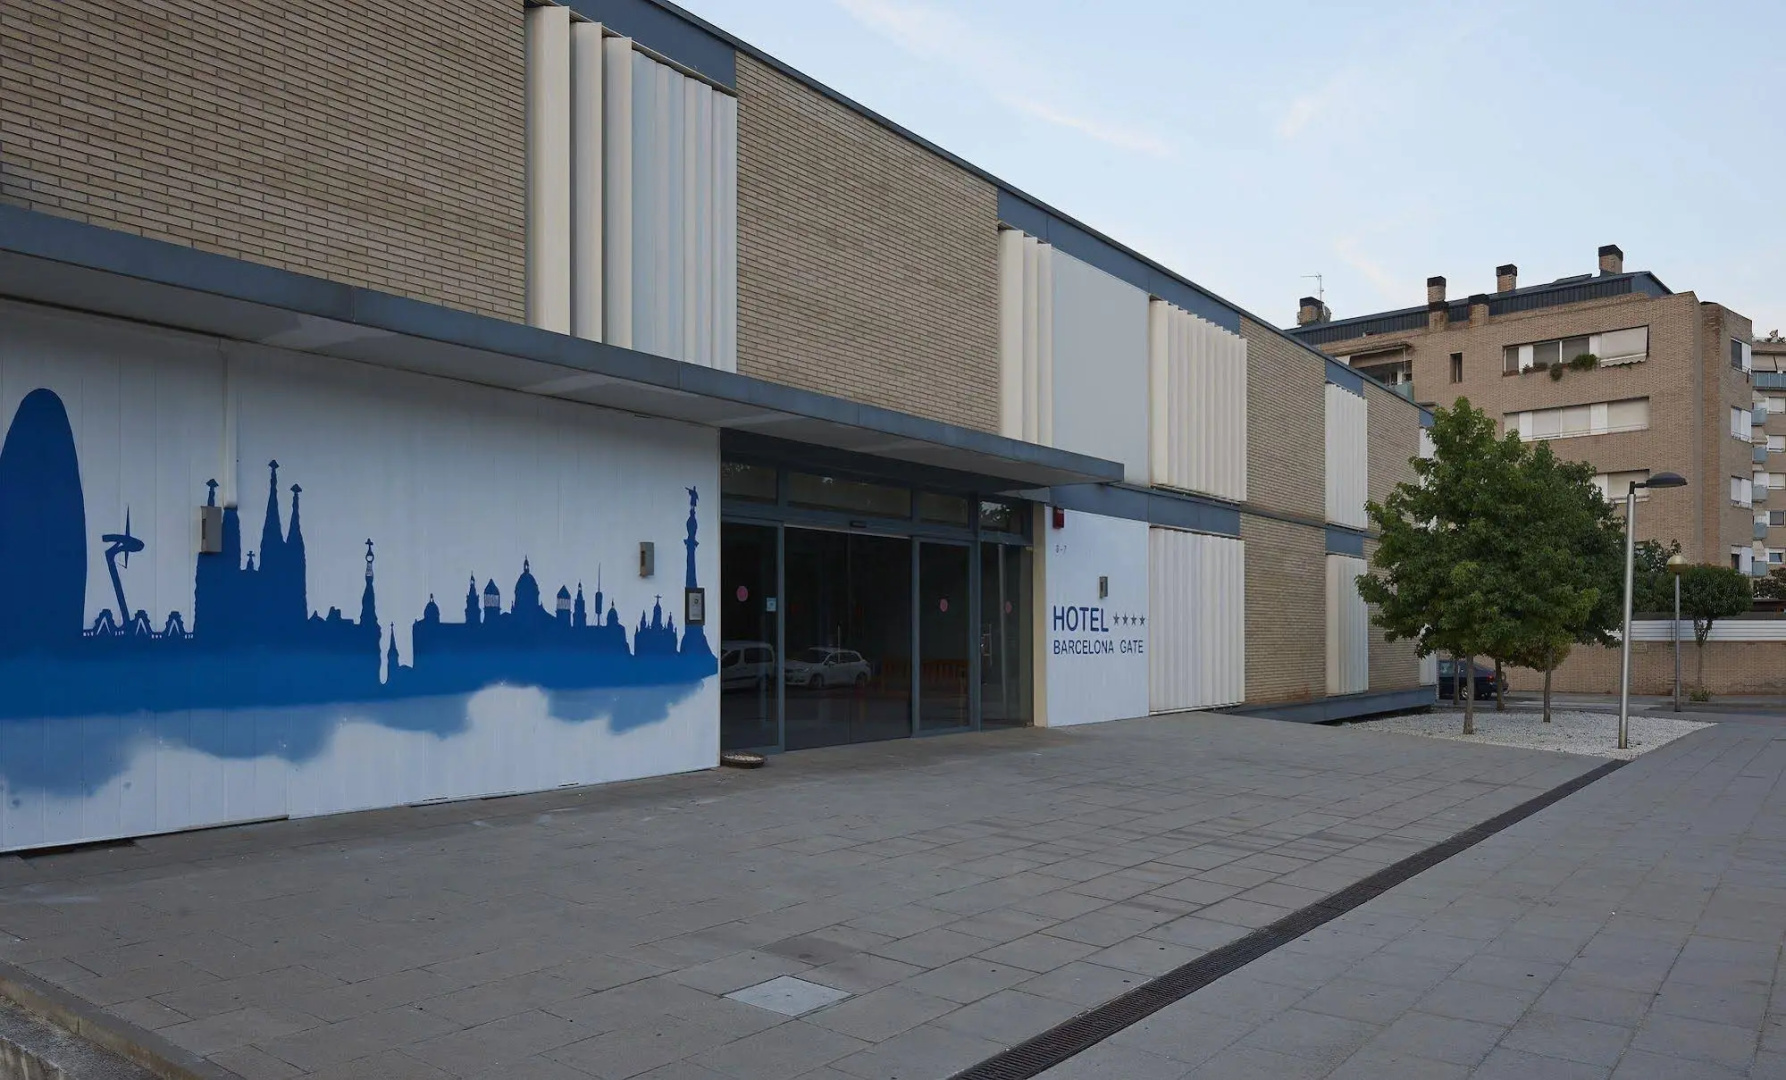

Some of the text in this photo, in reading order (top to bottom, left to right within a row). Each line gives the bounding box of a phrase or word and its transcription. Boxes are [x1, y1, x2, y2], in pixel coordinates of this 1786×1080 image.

[1053, 605, 1109, 632] HOTEL
[1053, 639, 1144, 655] BARCELONA GATE
